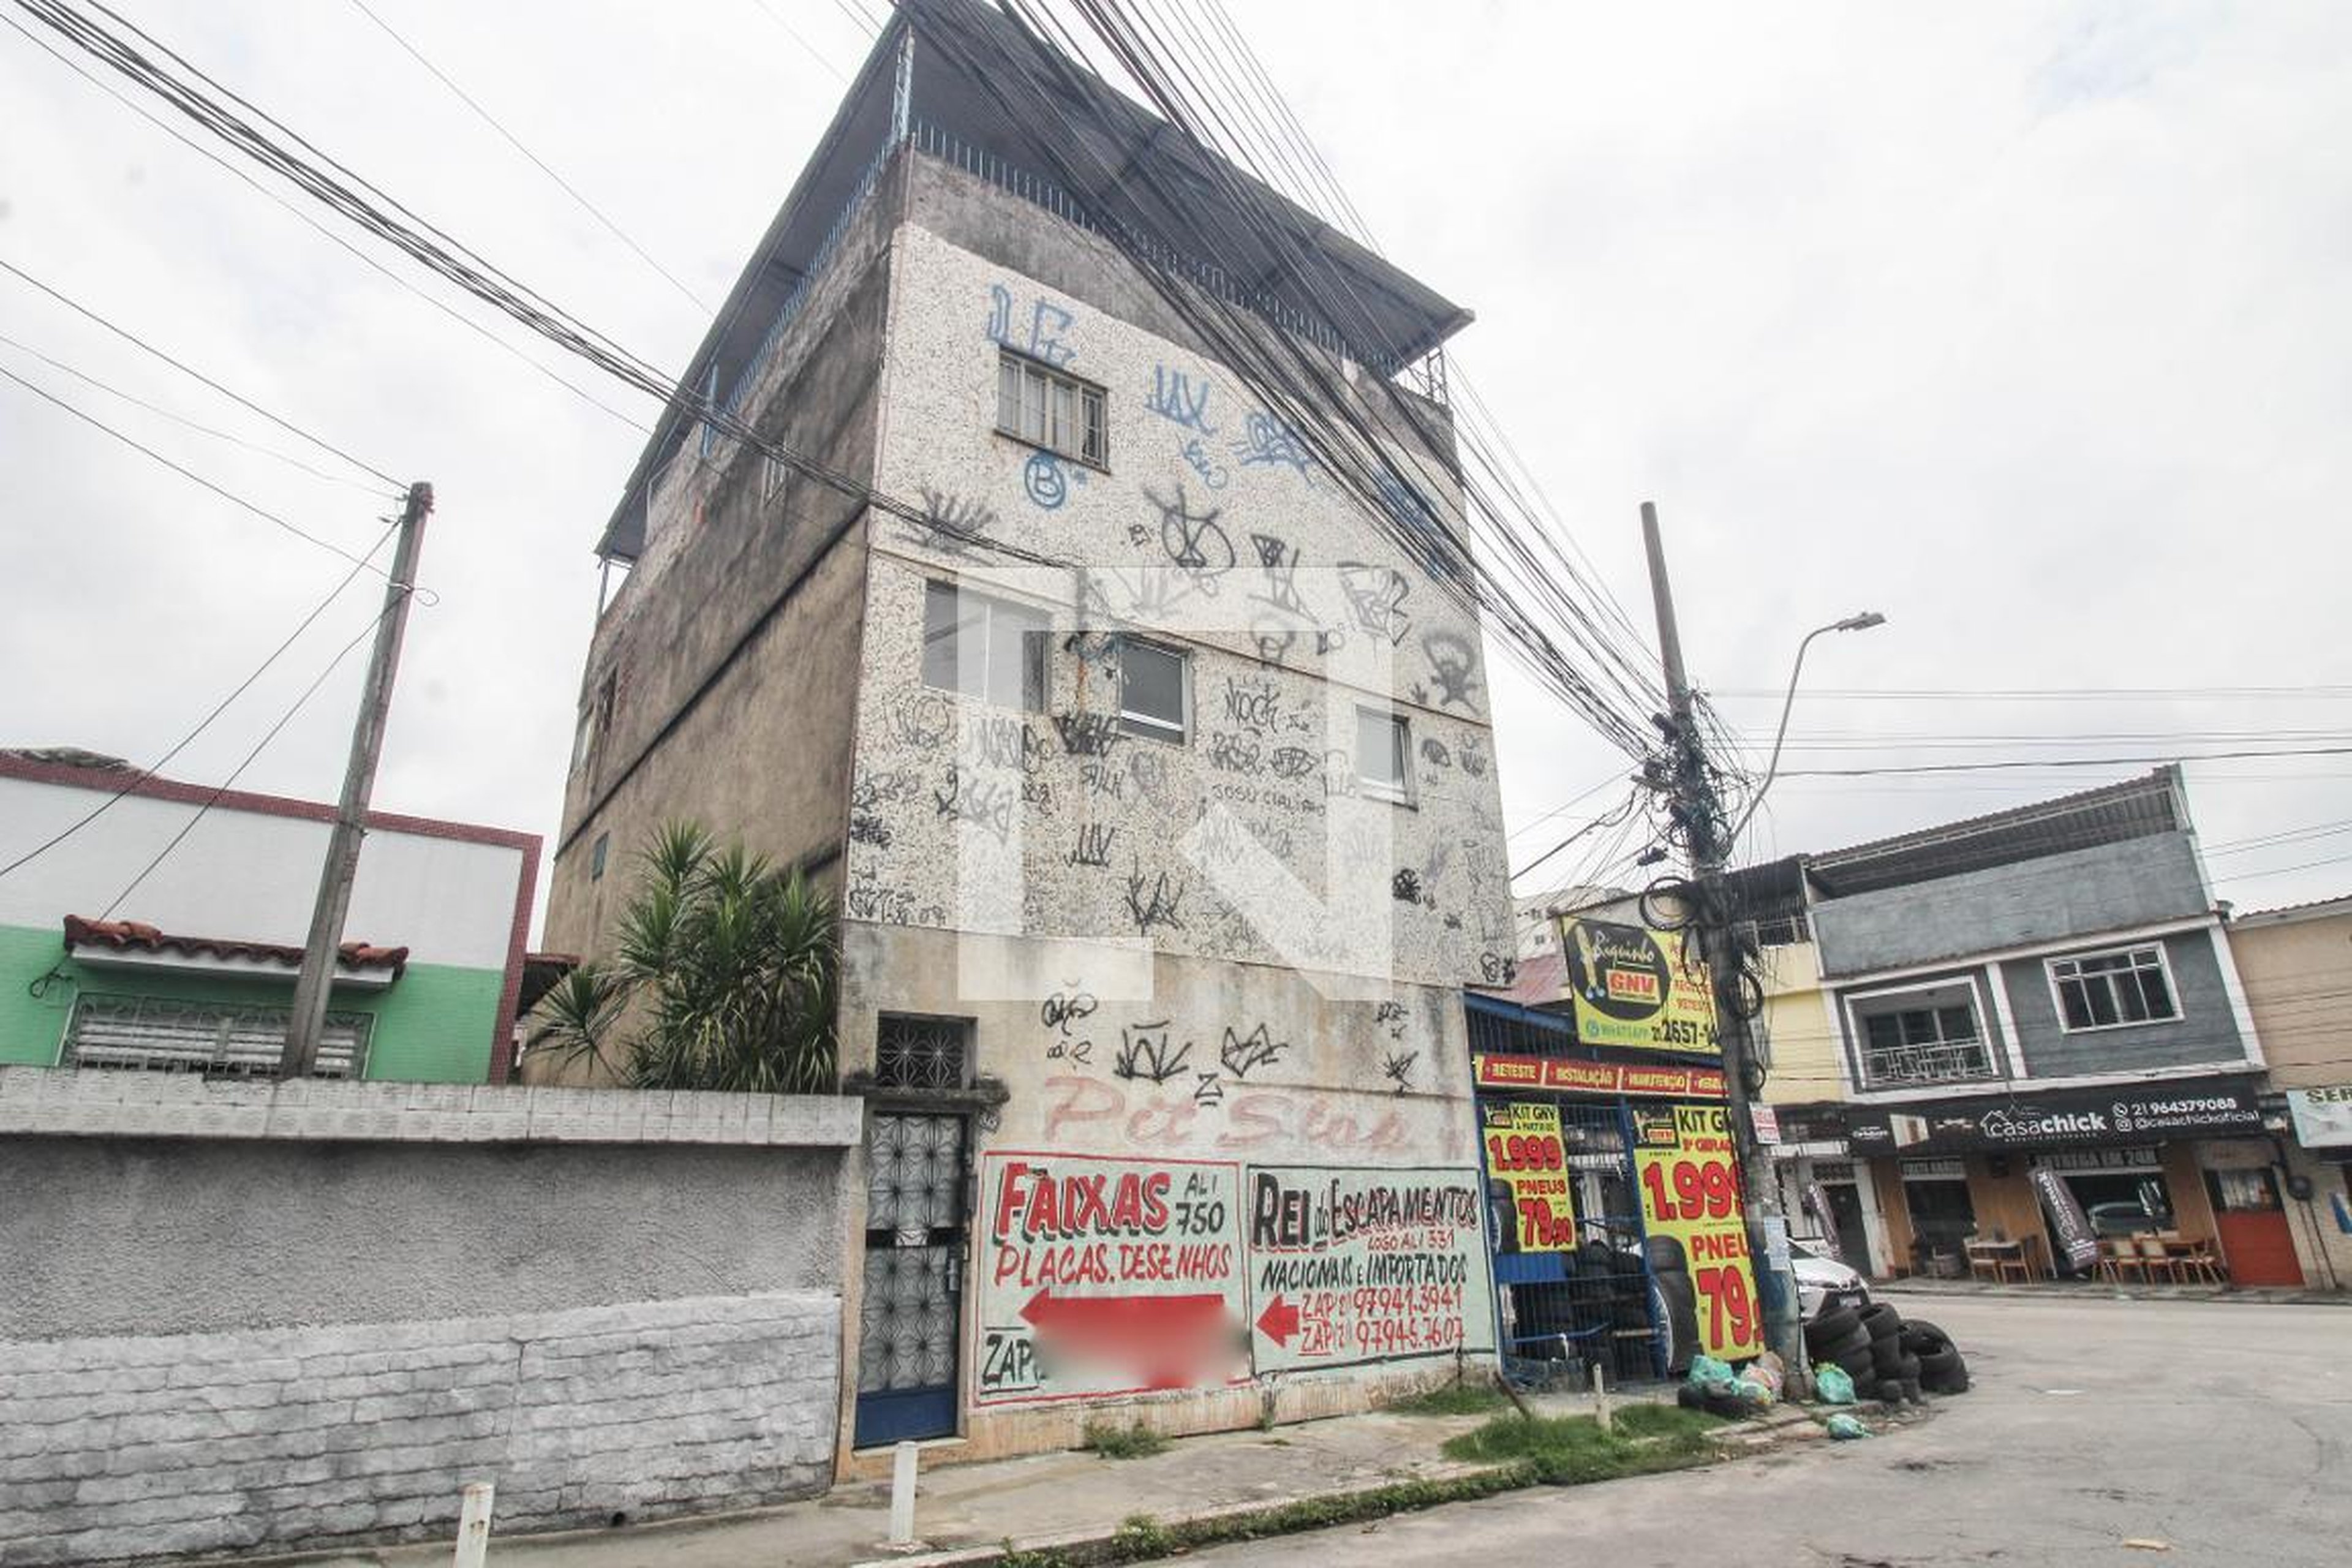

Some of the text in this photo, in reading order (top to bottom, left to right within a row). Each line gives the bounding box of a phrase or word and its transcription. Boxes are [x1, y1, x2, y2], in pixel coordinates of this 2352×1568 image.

[1609, 973, 1654, 992] GNV
[1512, 1106, 1531, 1120] KIT
[1533, 1106, 1555, 1121] GNV
[1678, 1109, 1706, 1133] KIT
[1990, 1112, 2108, 1137] casachick
[1488, 1134, 1562, 1171] 1.999
[993, 1163, 1171, 1246] FAIXAS
[1517, 1179, 1566, 1195] PNEUS
[1175, 1200, 1224, 1235] 750
[1252, 1172, 1311, 1251] REI
[1329, 1177, 1477, 1240] ESCAPAMENTOS
[1119, 1243, 1232, 1281] DESENHOS
[1261, 1254, 1352, 1292] NACIONAIS
[1366, 1253, 1467, 1287] IMPORTADOS
